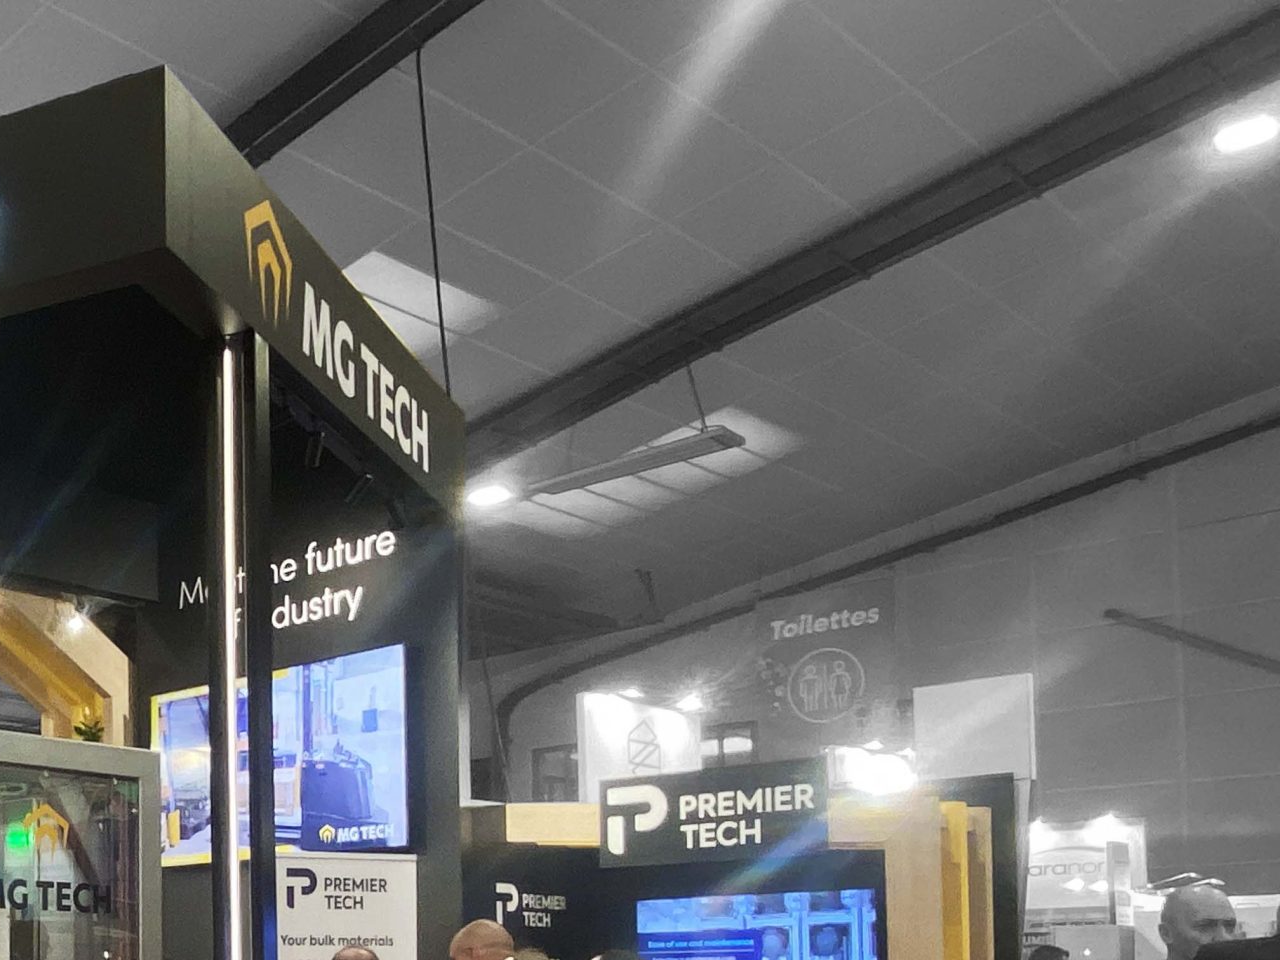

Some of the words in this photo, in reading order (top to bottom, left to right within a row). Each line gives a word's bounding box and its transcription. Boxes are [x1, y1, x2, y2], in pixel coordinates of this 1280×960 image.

[302, 281, 356, 398] MG
[360, 342, 429, 473] TECH
[305, 530, 396, 576] future
[272, 586, 363, 629] dustry
[770, 606, 880, 640] Toilettes
[679, 783, 815, 820] PREMIER
[337, 827, 359, 843] MG
[360, 824, 395, 840] TECH
[679, 818, 762, 849] TECH
[36, 881, 112, 913] TECH
[324, 877, 388, 893] PREMIER
[324, 895, 364, 910] TECH
[522, 893, 566, 910] PREMIER
[522, 911, 551, 927] TECH
[280, 935, 306, 946] Your
[309, 935, 335, 946] bulk
[338, 935, 394, 946] materials
